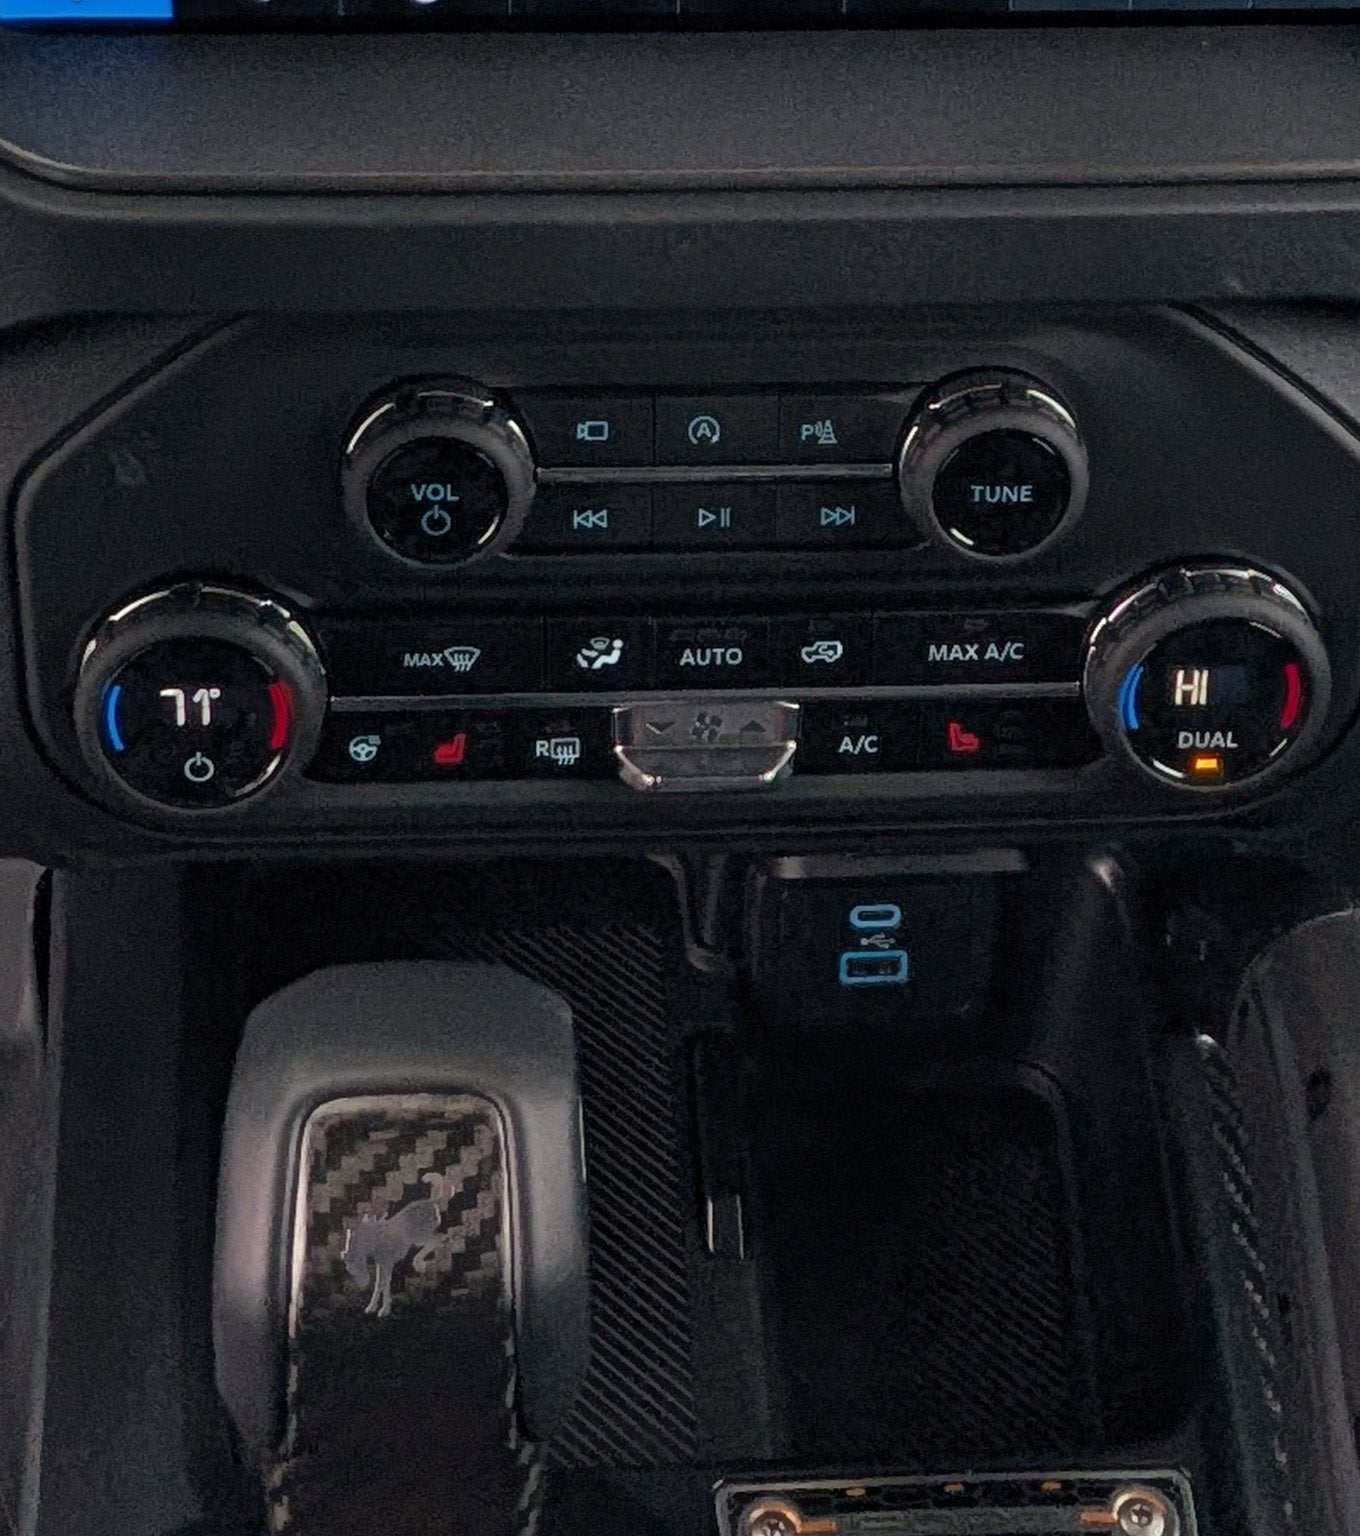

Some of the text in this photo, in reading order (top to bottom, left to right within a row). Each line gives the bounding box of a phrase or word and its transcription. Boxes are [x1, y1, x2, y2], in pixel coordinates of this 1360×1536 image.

[410, 483, 459, 503] VOL
[970, 484, 1034, 505] TUNE
[403, 651, 444, 670] MAX
[679, 647, 743, 667] AUTO
[927, 640, 1025, 663] MAX A/C
[1173, 668, 1209, 707] HI
[838, 734, 879, 755] A/C
[1177, 730, 1239, 750] DUAL
